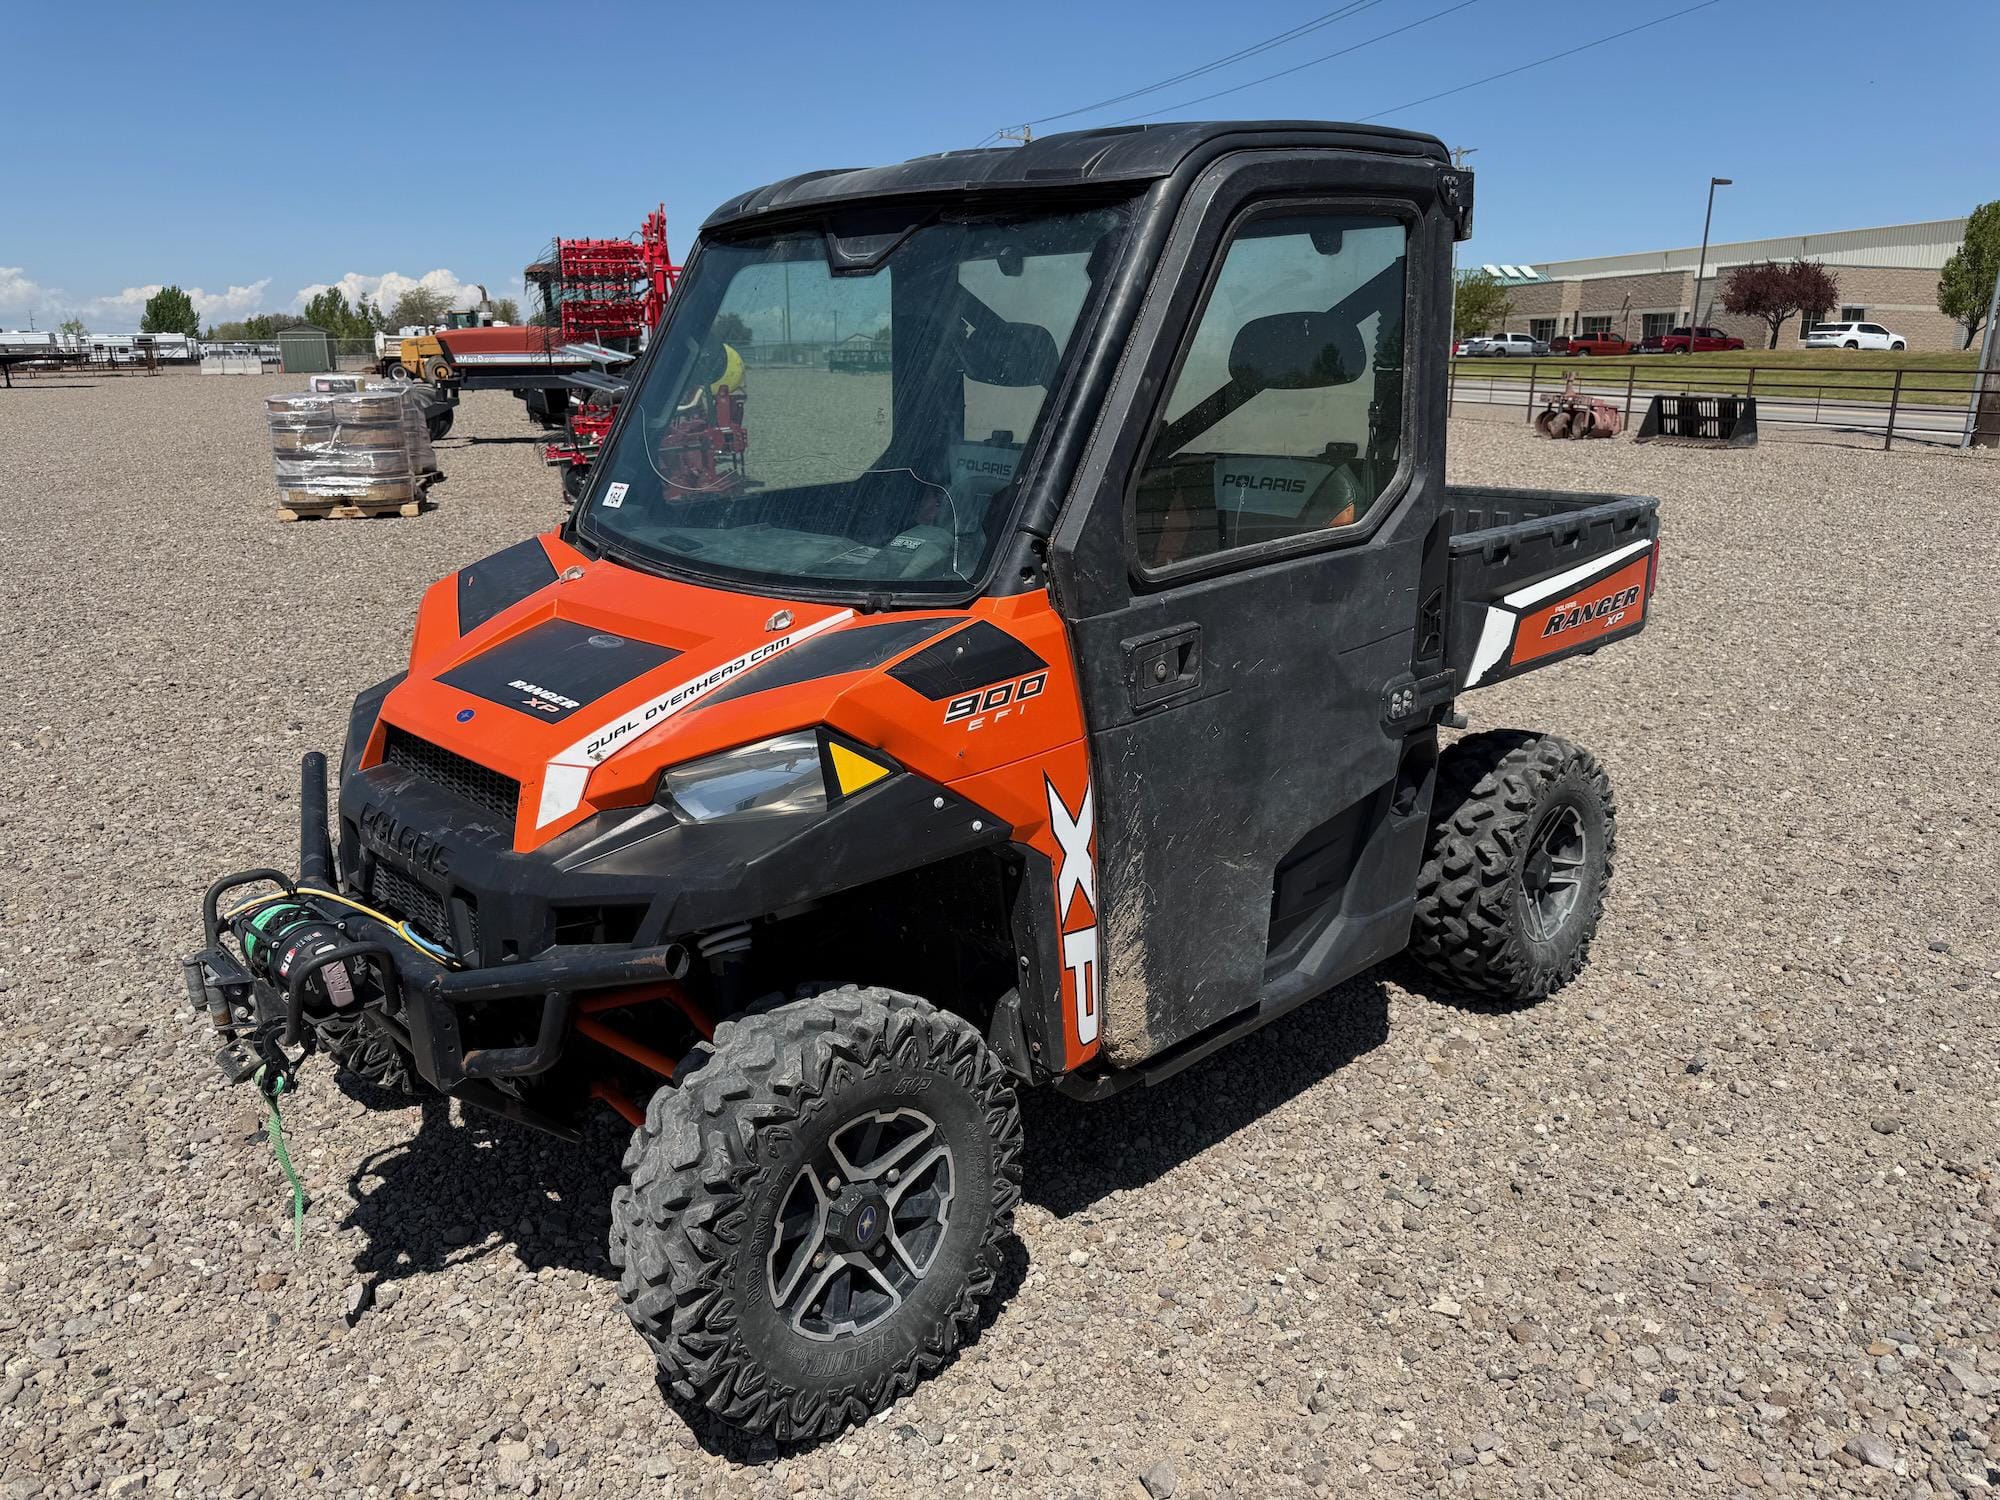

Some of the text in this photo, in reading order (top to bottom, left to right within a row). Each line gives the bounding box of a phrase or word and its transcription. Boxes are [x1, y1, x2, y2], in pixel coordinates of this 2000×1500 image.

[957, 457, 1012, 477] POLARIS
[1222, 474, 1307, 493] POLARIS
[1540, 584, 1641, 639] RANGER
[1604, 611, 1625, 628] XP
[507, 678, 581, 710] RANGER
[520, 696, 561, 714] XP
[586, 636, 791, 756] DUAL OVERHEAD CAM
[944, 671, 1049, 725] 900
[359, 801, 457, 876] POLARIS
[1042, 767, 1099, 1046] XP
[804, 1329, 897, 1379] SEDONA
